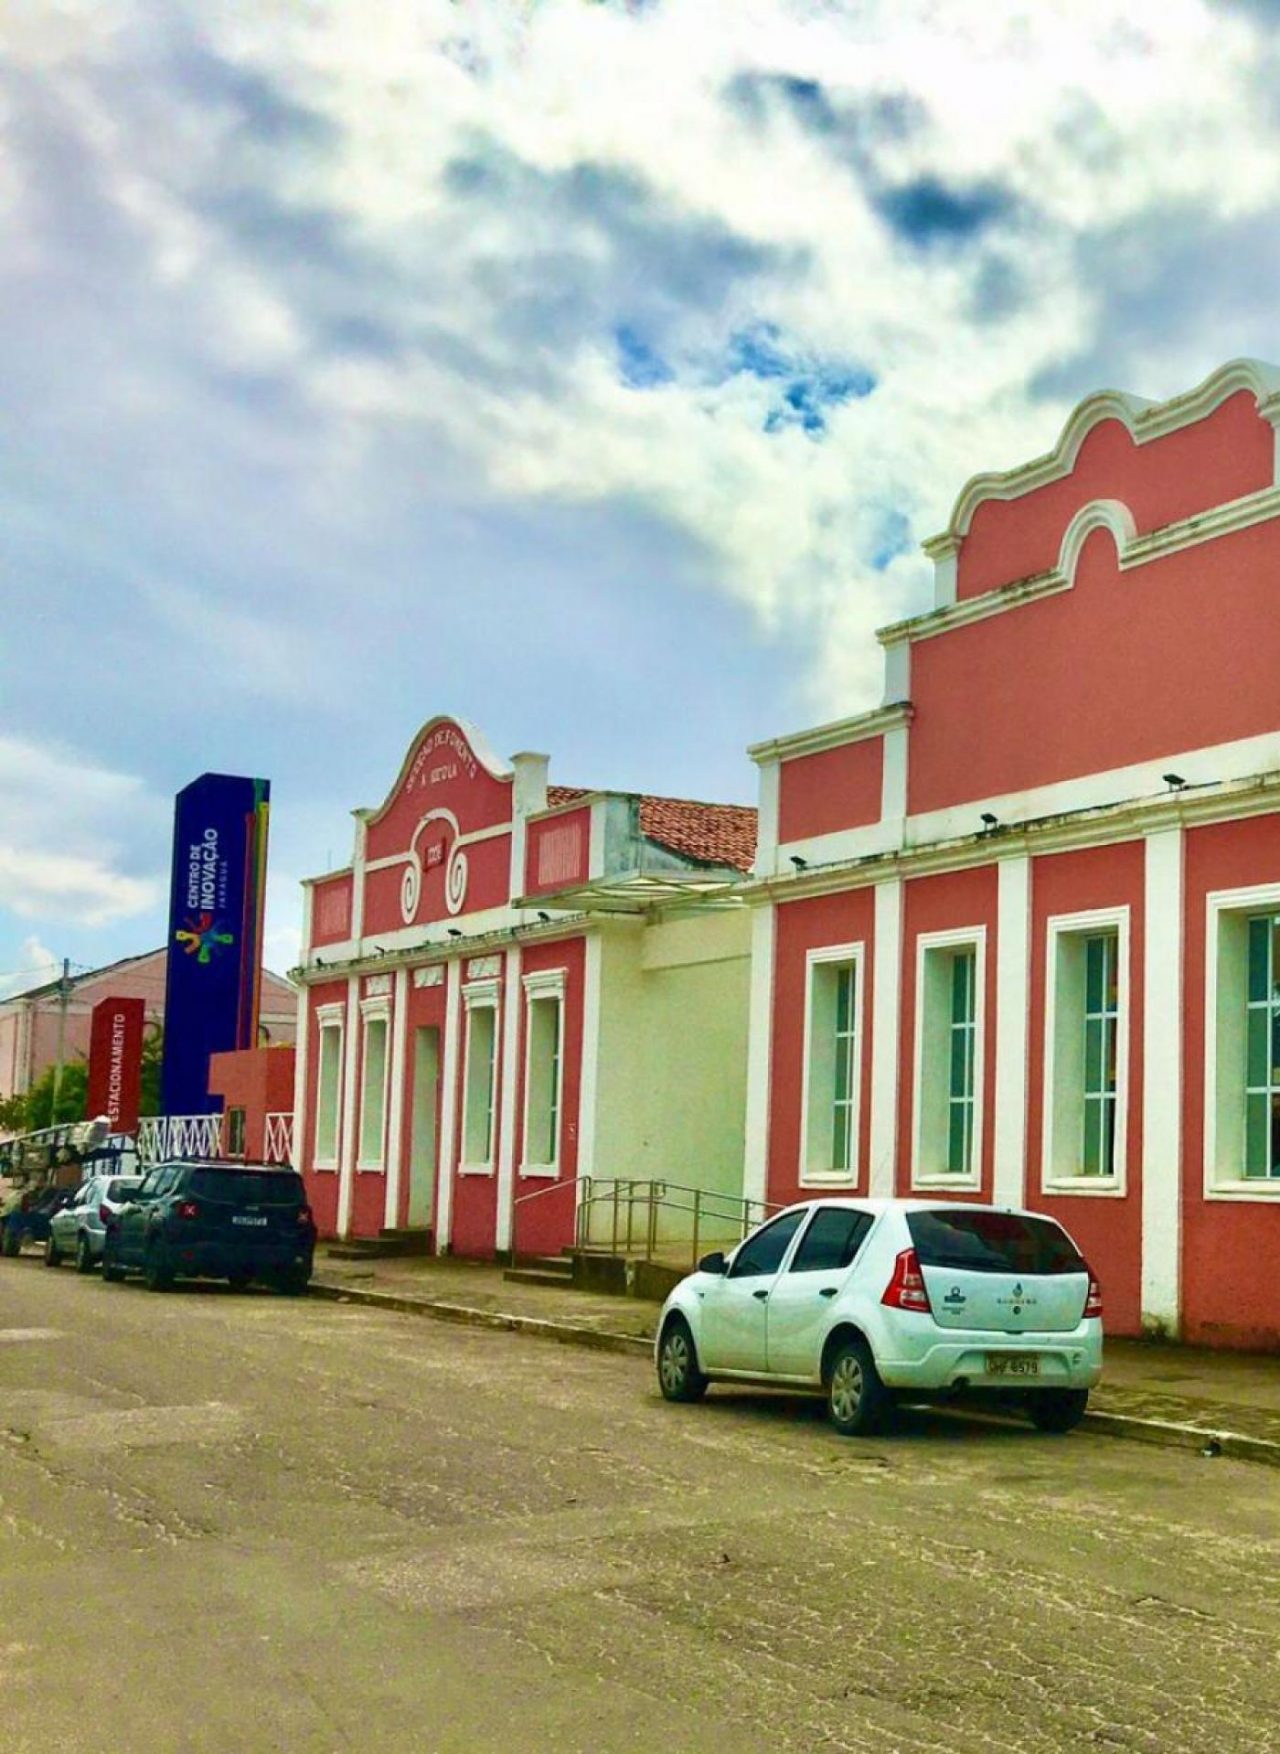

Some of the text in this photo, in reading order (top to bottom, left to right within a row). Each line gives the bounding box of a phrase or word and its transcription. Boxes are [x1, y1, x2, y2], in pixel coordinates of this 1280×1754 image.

[187, 844, 201, 908] CENTRO DE
[201, 828, 219, 910] INOVAÇÃO
[108, 1013, 125, 1122] ESTACIONAMENTO
